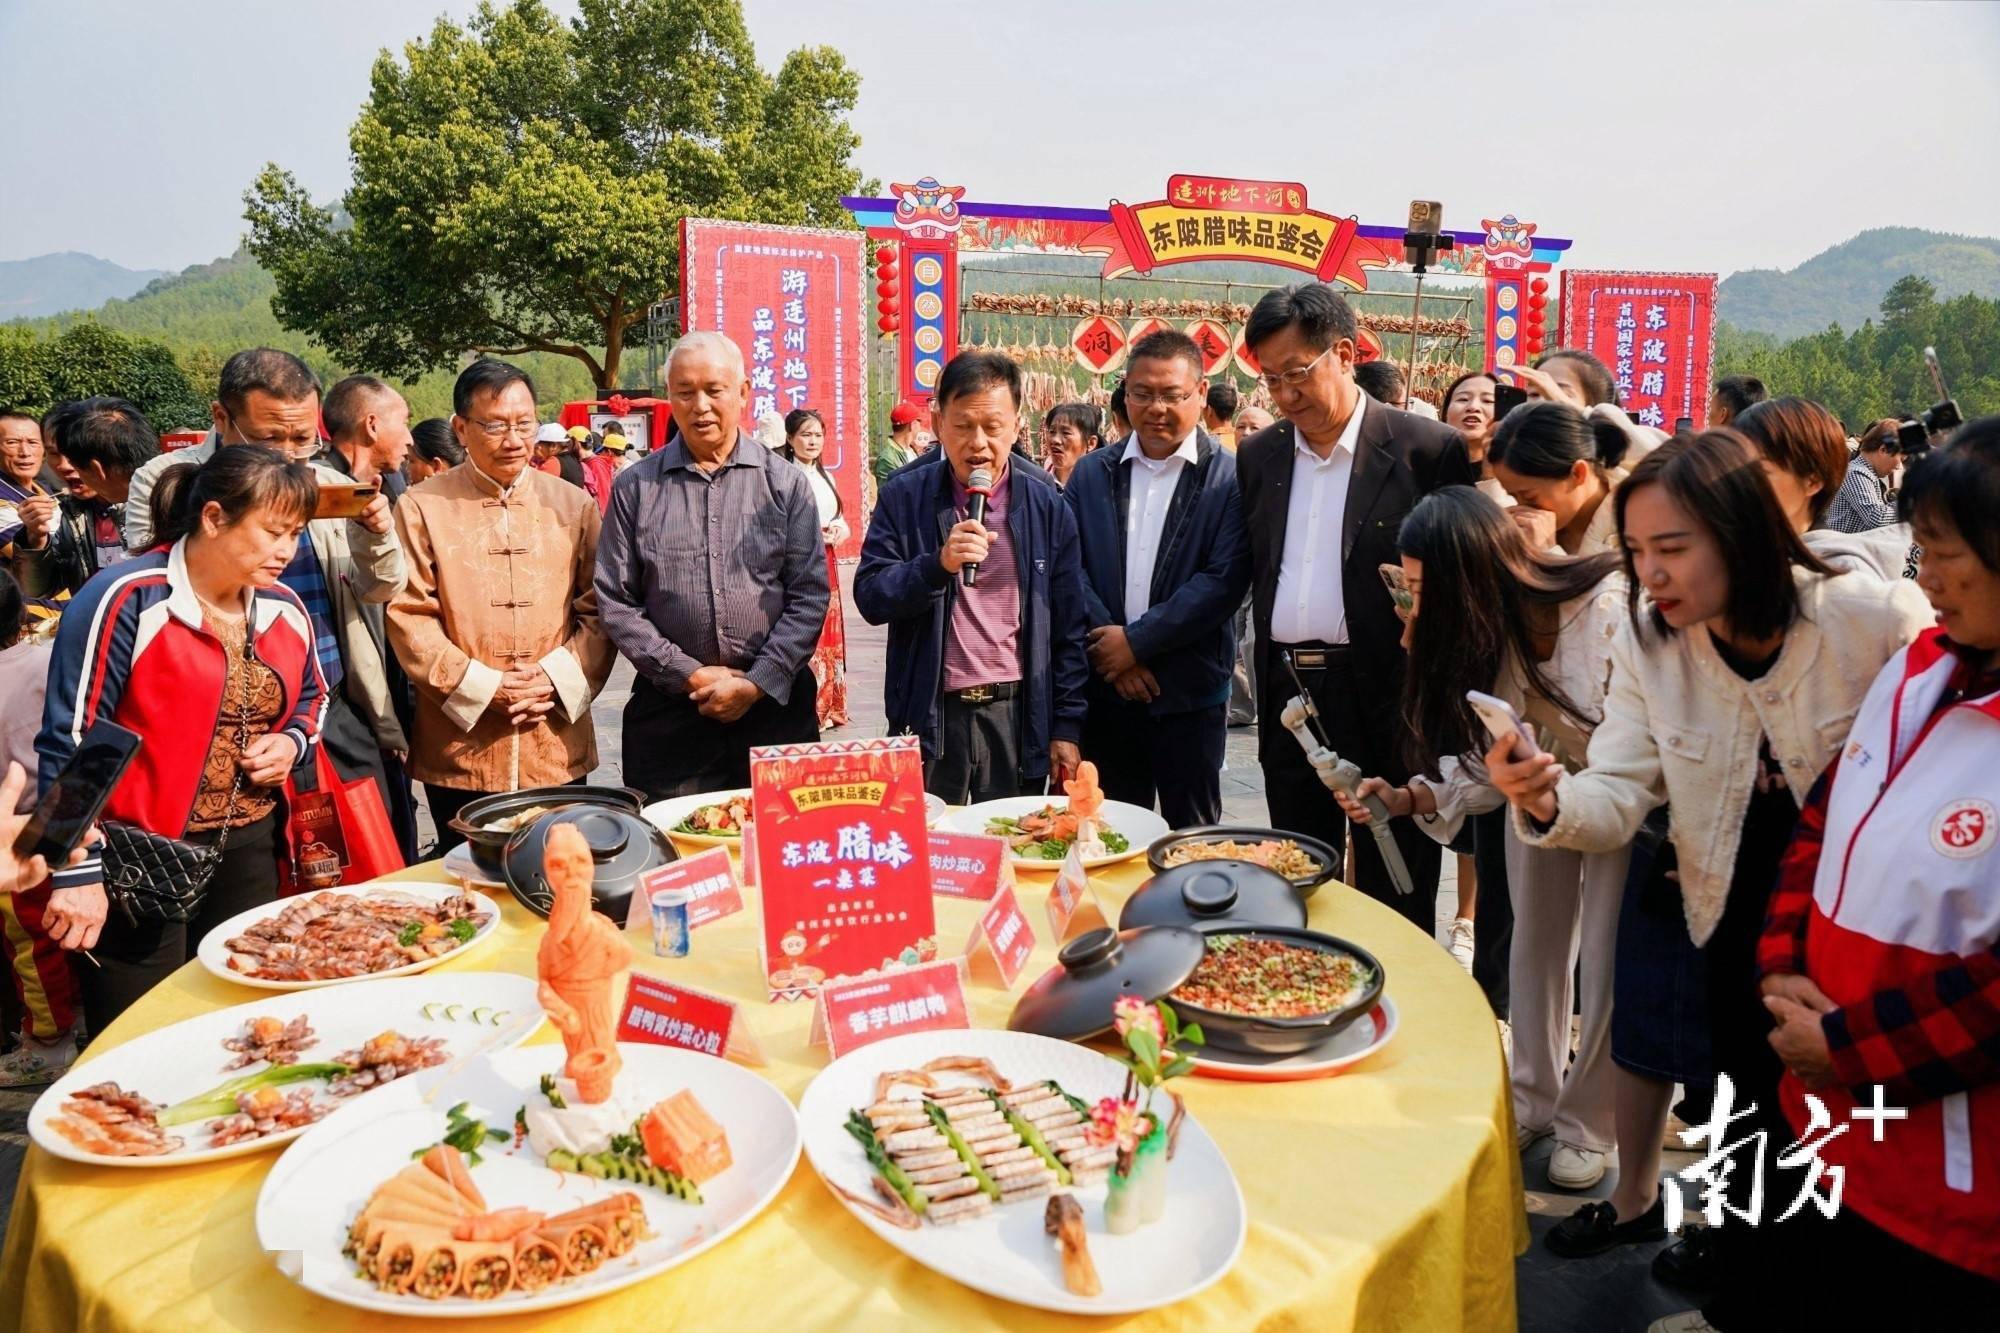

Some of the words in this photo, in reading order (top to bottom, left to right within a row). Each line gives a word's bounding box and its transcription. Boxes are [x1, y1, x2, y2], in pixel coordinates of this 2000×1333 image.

[1173, 180, 1283, 208] 连州地下河
[734, 244, 824, 260] 国家地理标志保护产品
[1149, 216, 1325, 261] 东陂腊味品鉴会
[1604, 287, 1681, 297] 国家地理标志保护产品
[1085, 332, 1111, 356] 洞
[1641, 304, 1667, 427] 东陂腊味
[796, 786, 882, 807] 东陂腊味品鉴会
[782, 821, 913, 869] 东陂腊味
[812, 866, 876, 889] 一桌菜
[848, 993, 948, 1034] 香芋麒麟鸭
[627, 1005, 721, 1055] 腊鸭肾炒菜心粒
